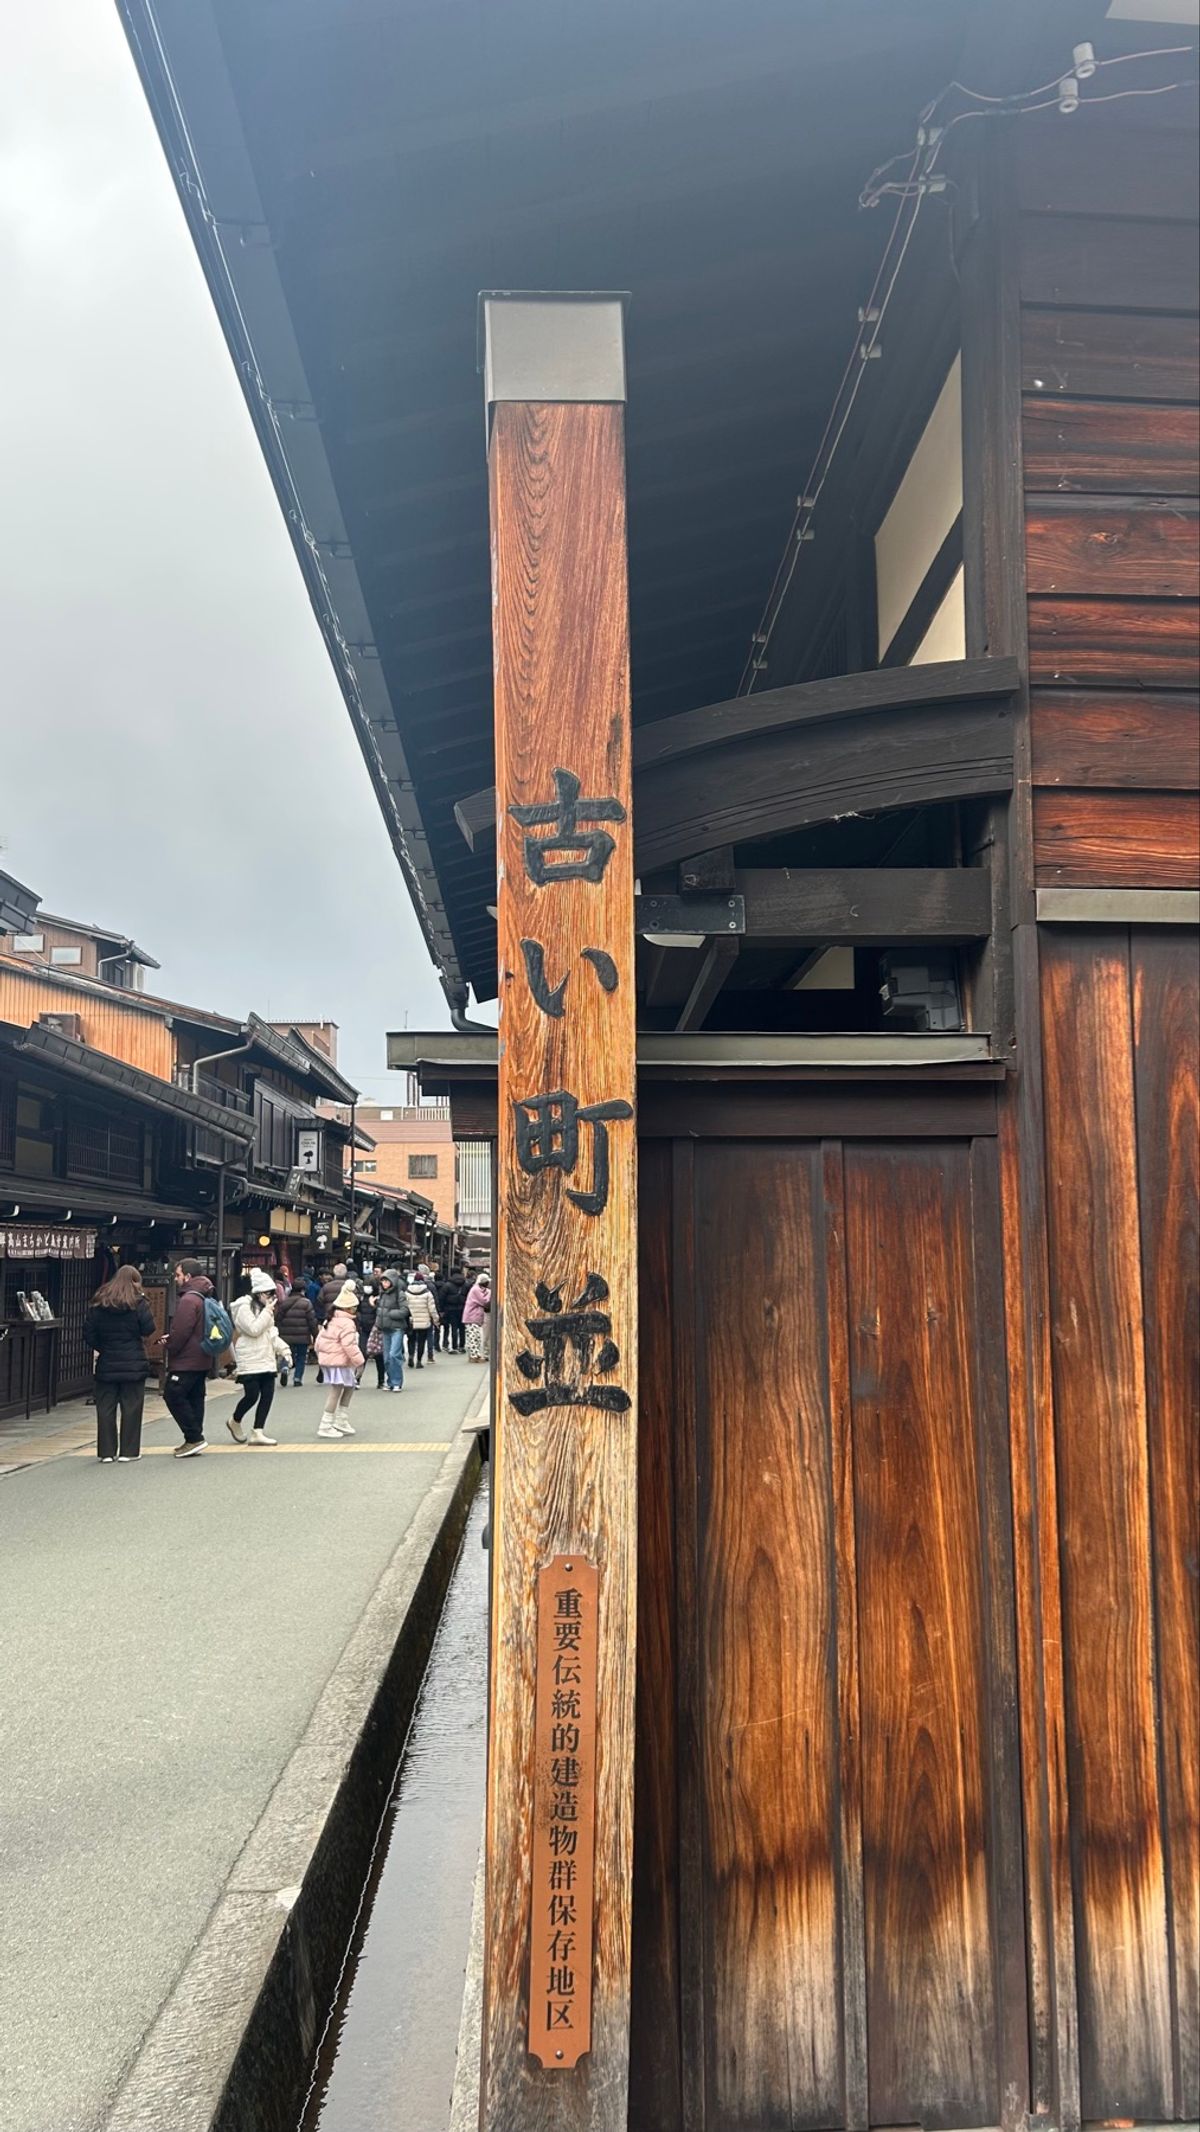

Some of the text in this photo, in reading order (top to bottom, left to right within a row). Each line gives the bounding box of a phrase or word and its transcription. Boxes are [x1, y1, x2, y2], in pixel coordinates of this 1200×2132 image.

[508, 766, 633, 1417] 古い町並
[546, 1587, 583, 2032] 重要伝統的建造物群保存地区
